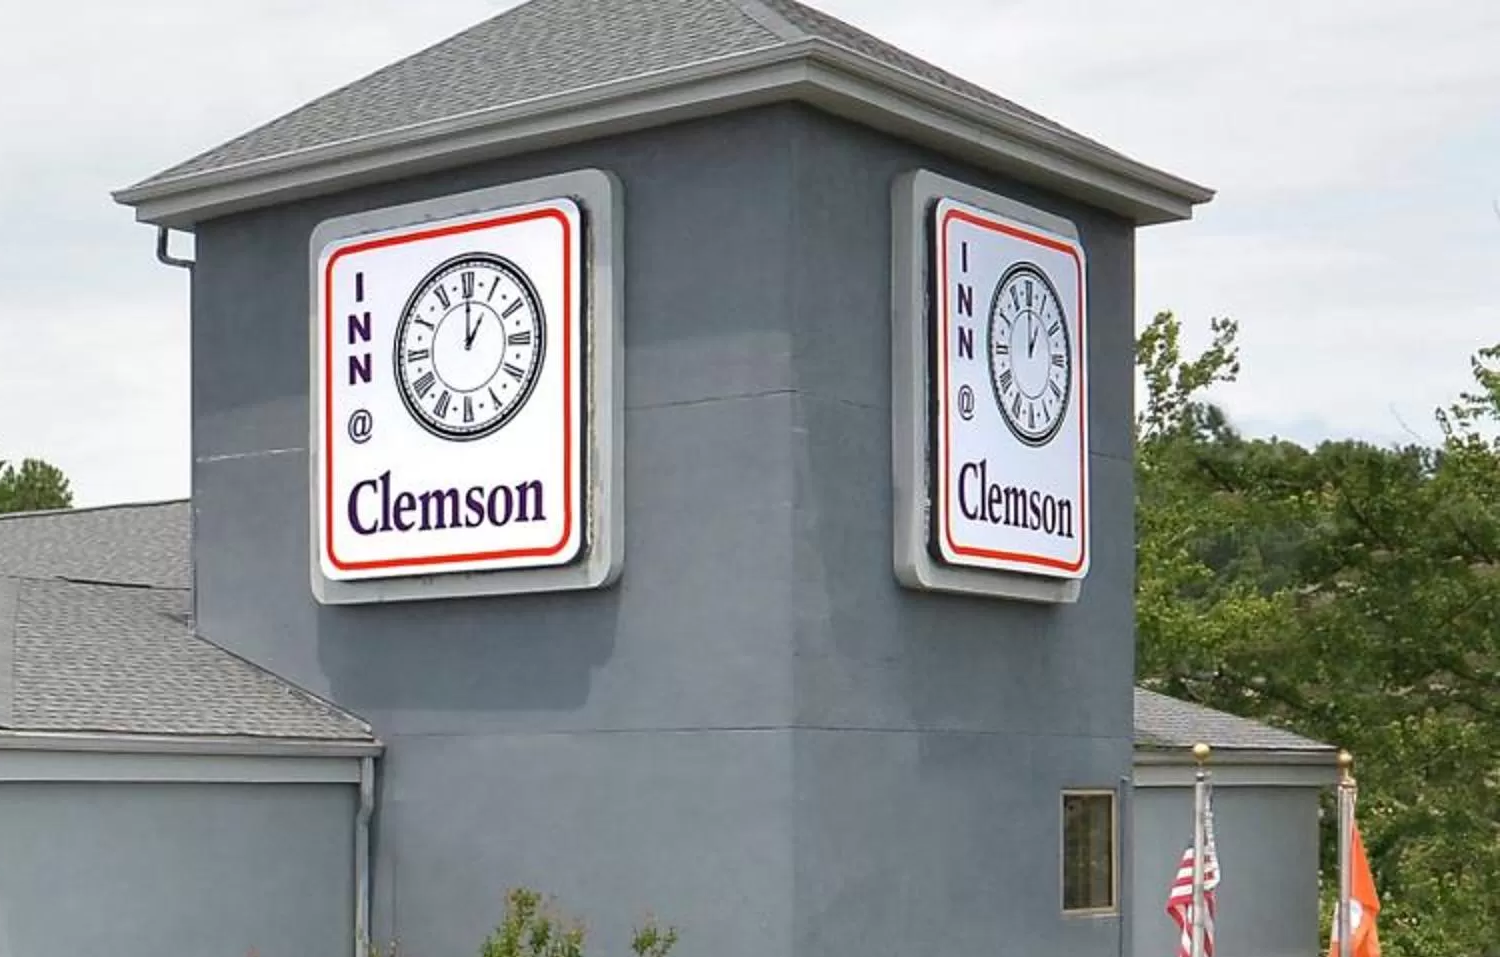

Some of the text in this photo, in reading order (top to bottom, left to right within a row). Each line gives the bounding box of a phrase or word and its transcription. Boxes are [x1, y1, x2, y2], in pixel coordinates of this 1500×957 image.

[347, 272, 373, 444] INN @
[957, 242, 975, 422] INN @
[347, 470, 547, 536] Clemson
[957, 459, 1074, 539] Clemson
